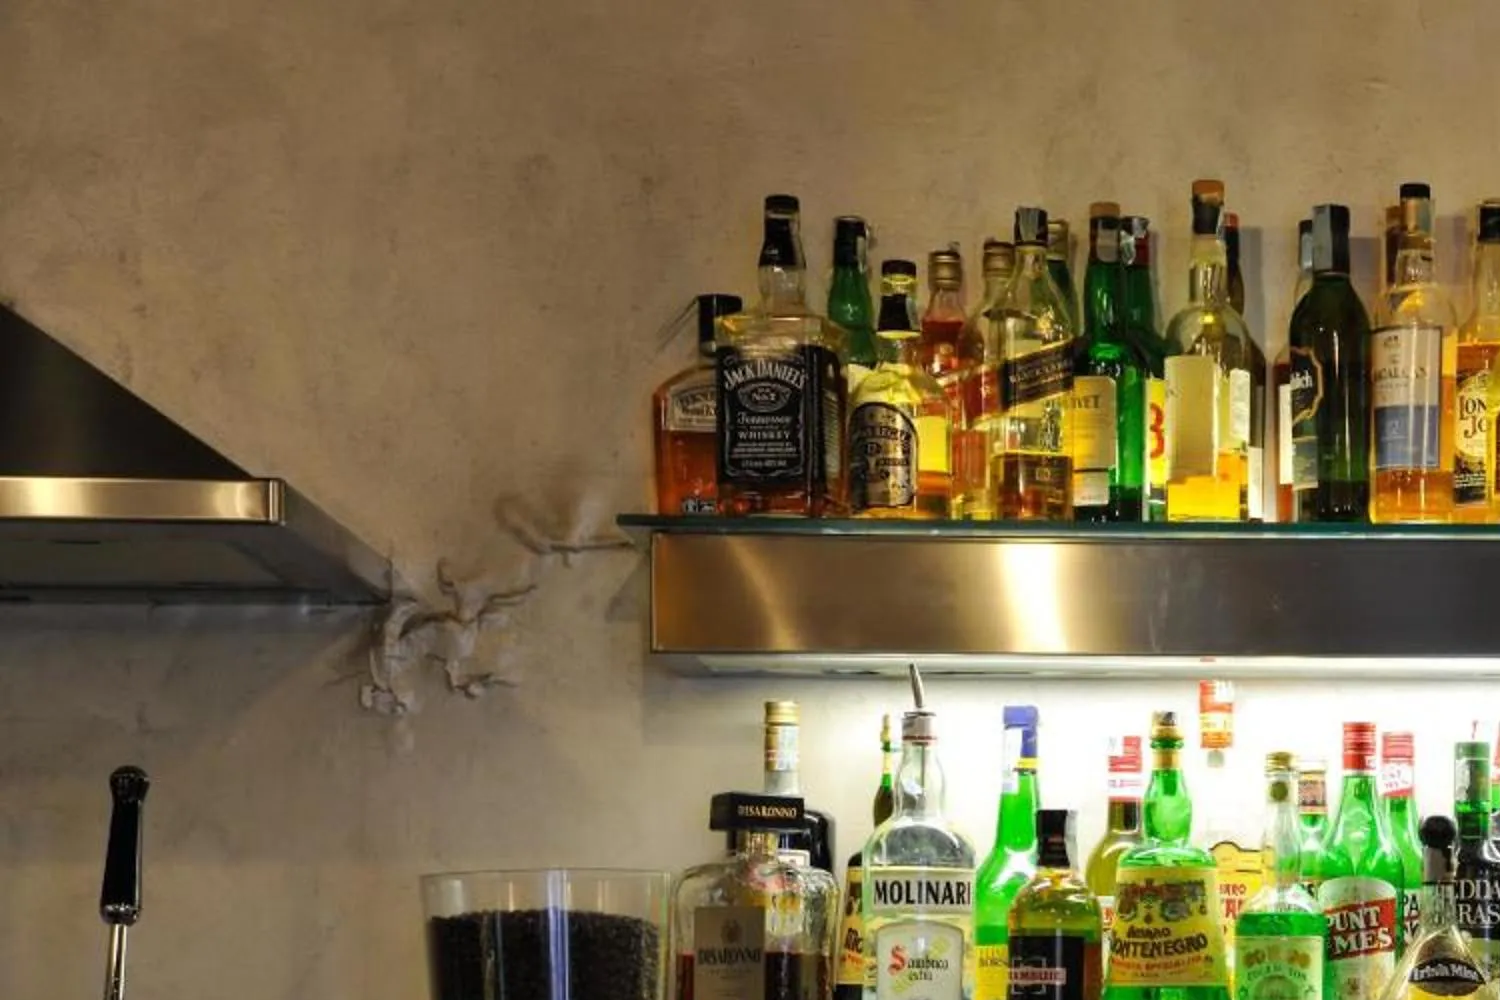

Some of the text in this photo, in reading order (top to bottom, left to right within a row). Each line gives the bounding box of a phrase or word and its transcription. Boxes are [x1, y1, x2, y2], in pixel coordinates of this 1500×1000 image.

[724, 358, 809, 390] JACK DANIEL'S
[737, 431, 790, 440] WHISKEY
[738, 804, 798, 819] DISARONNO
[874, 881, 972, 905] MOLINARI
[1326, 907, 1381, 932] PUNT
[1335, 927, 1393, 955] MES
